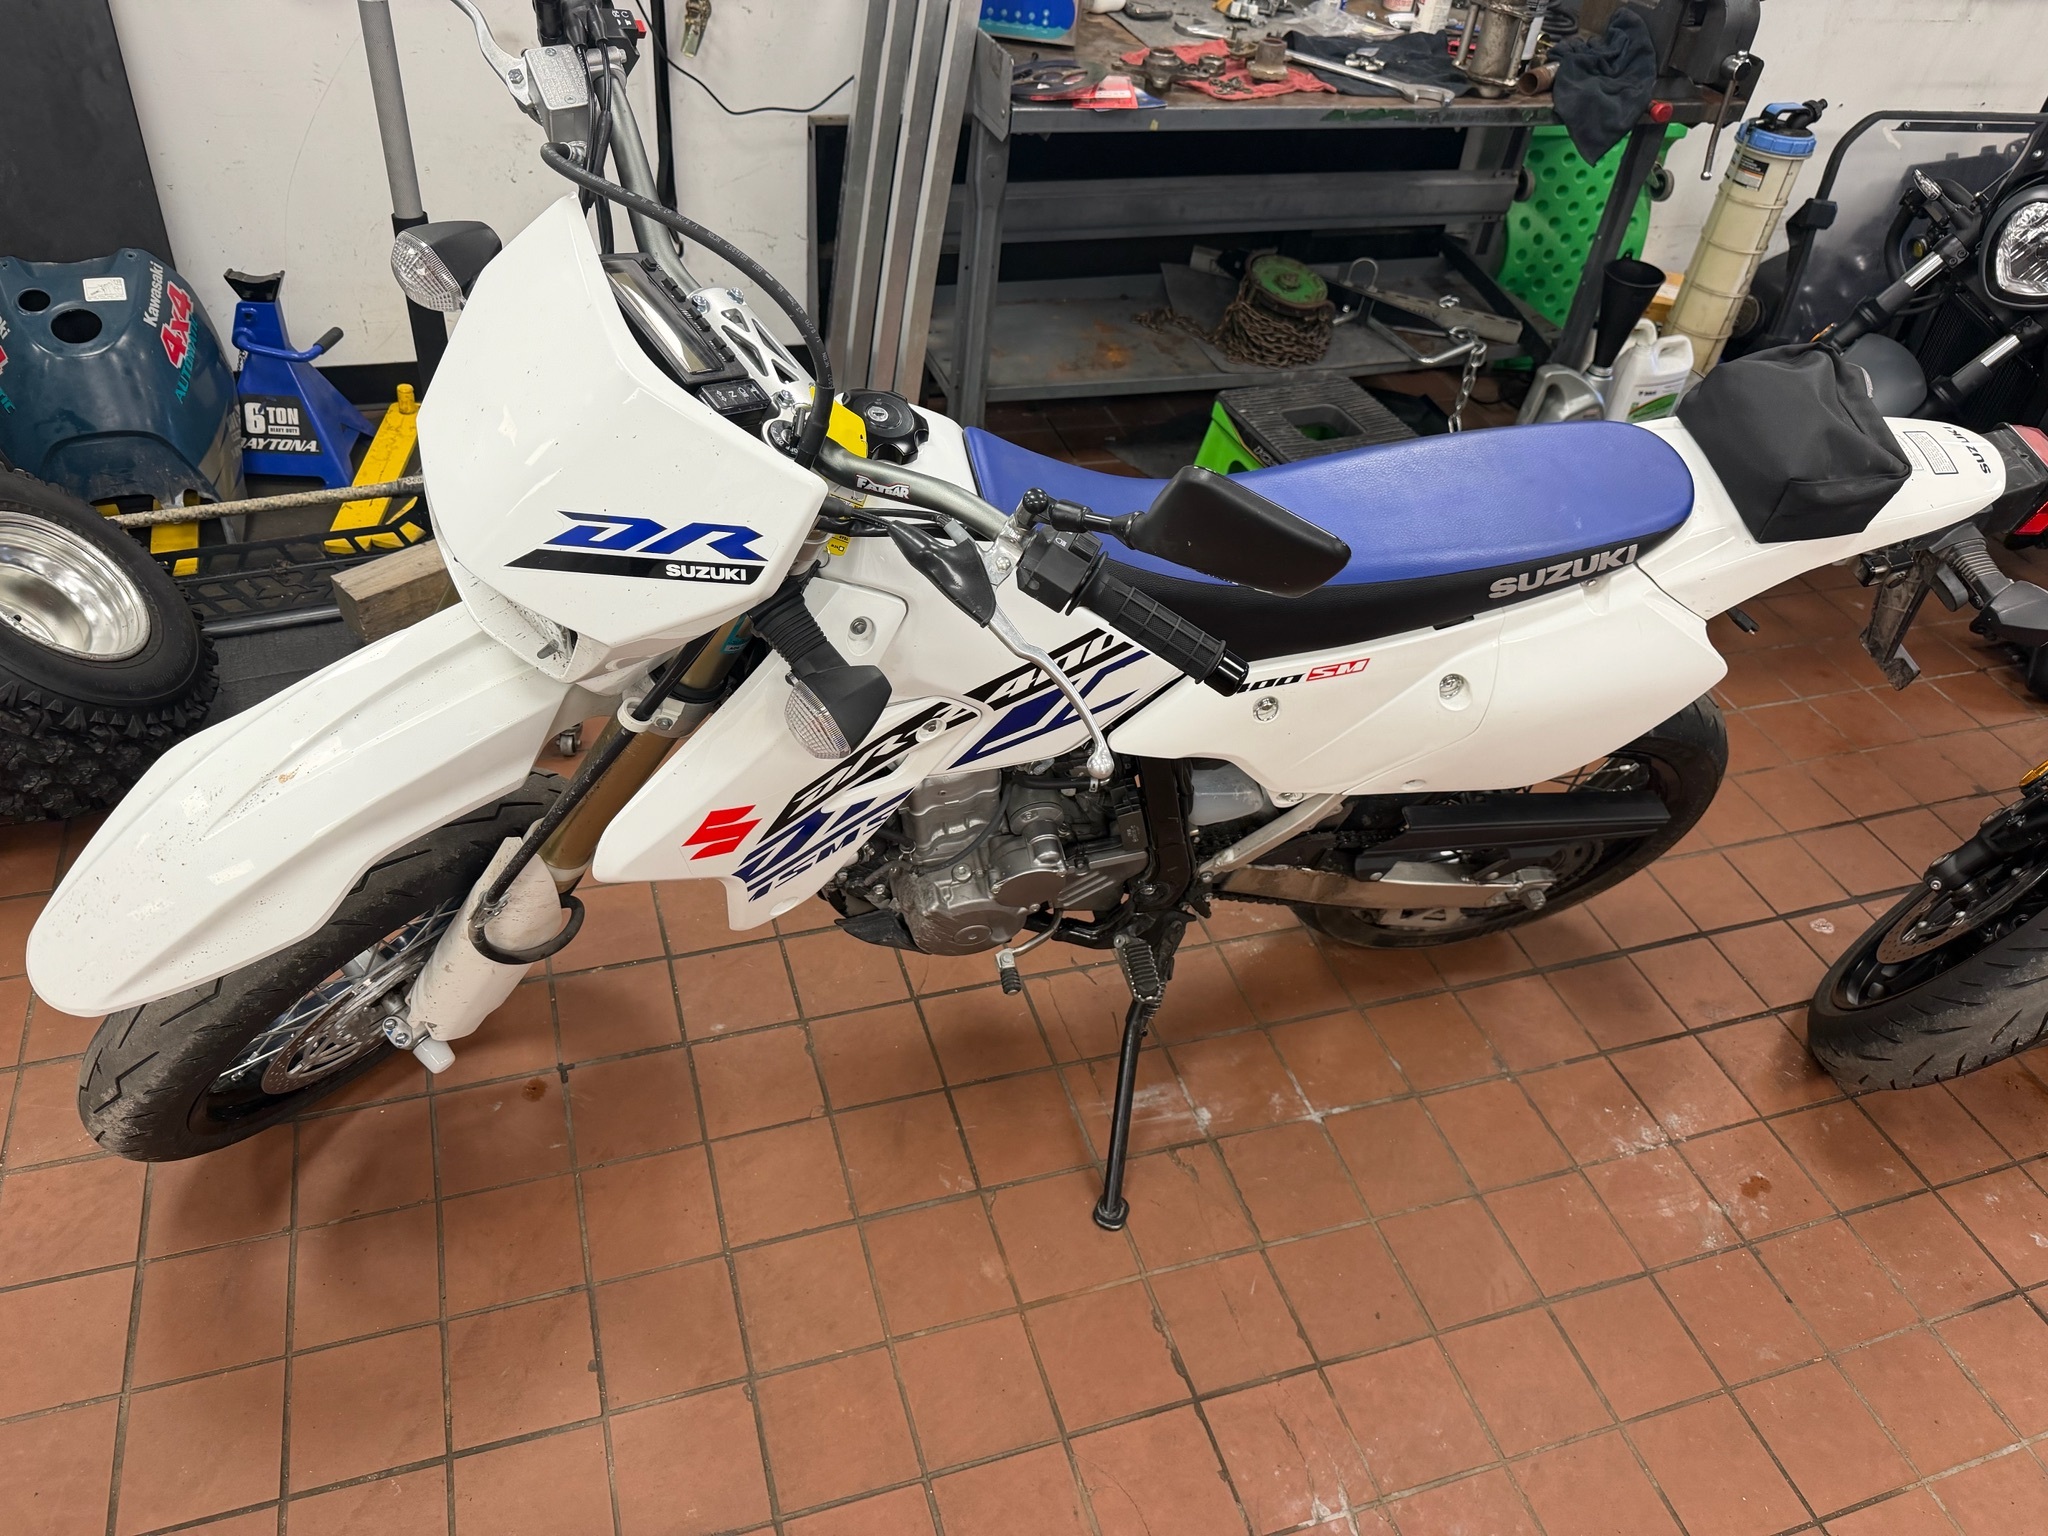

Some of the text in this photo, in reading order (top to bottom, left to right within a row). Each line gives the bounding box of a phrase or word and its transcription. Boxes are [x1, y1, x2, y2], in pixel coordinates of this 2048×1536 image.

[143, 260, 164, 327] Kawasaki
[244, 402, 266, 434] 6
[266, 406, 300, 425] TON
[1942, 425, 1992, 475] SUZUKI
[856, 474, 910, 500] FATBAR
[543, 510, 769, 561] DR
[665, 563, 747, 581] SUZUKI
[1488, 543, 1638, 599] SUZUKI
[1306, 658, 1371, 682] SM
